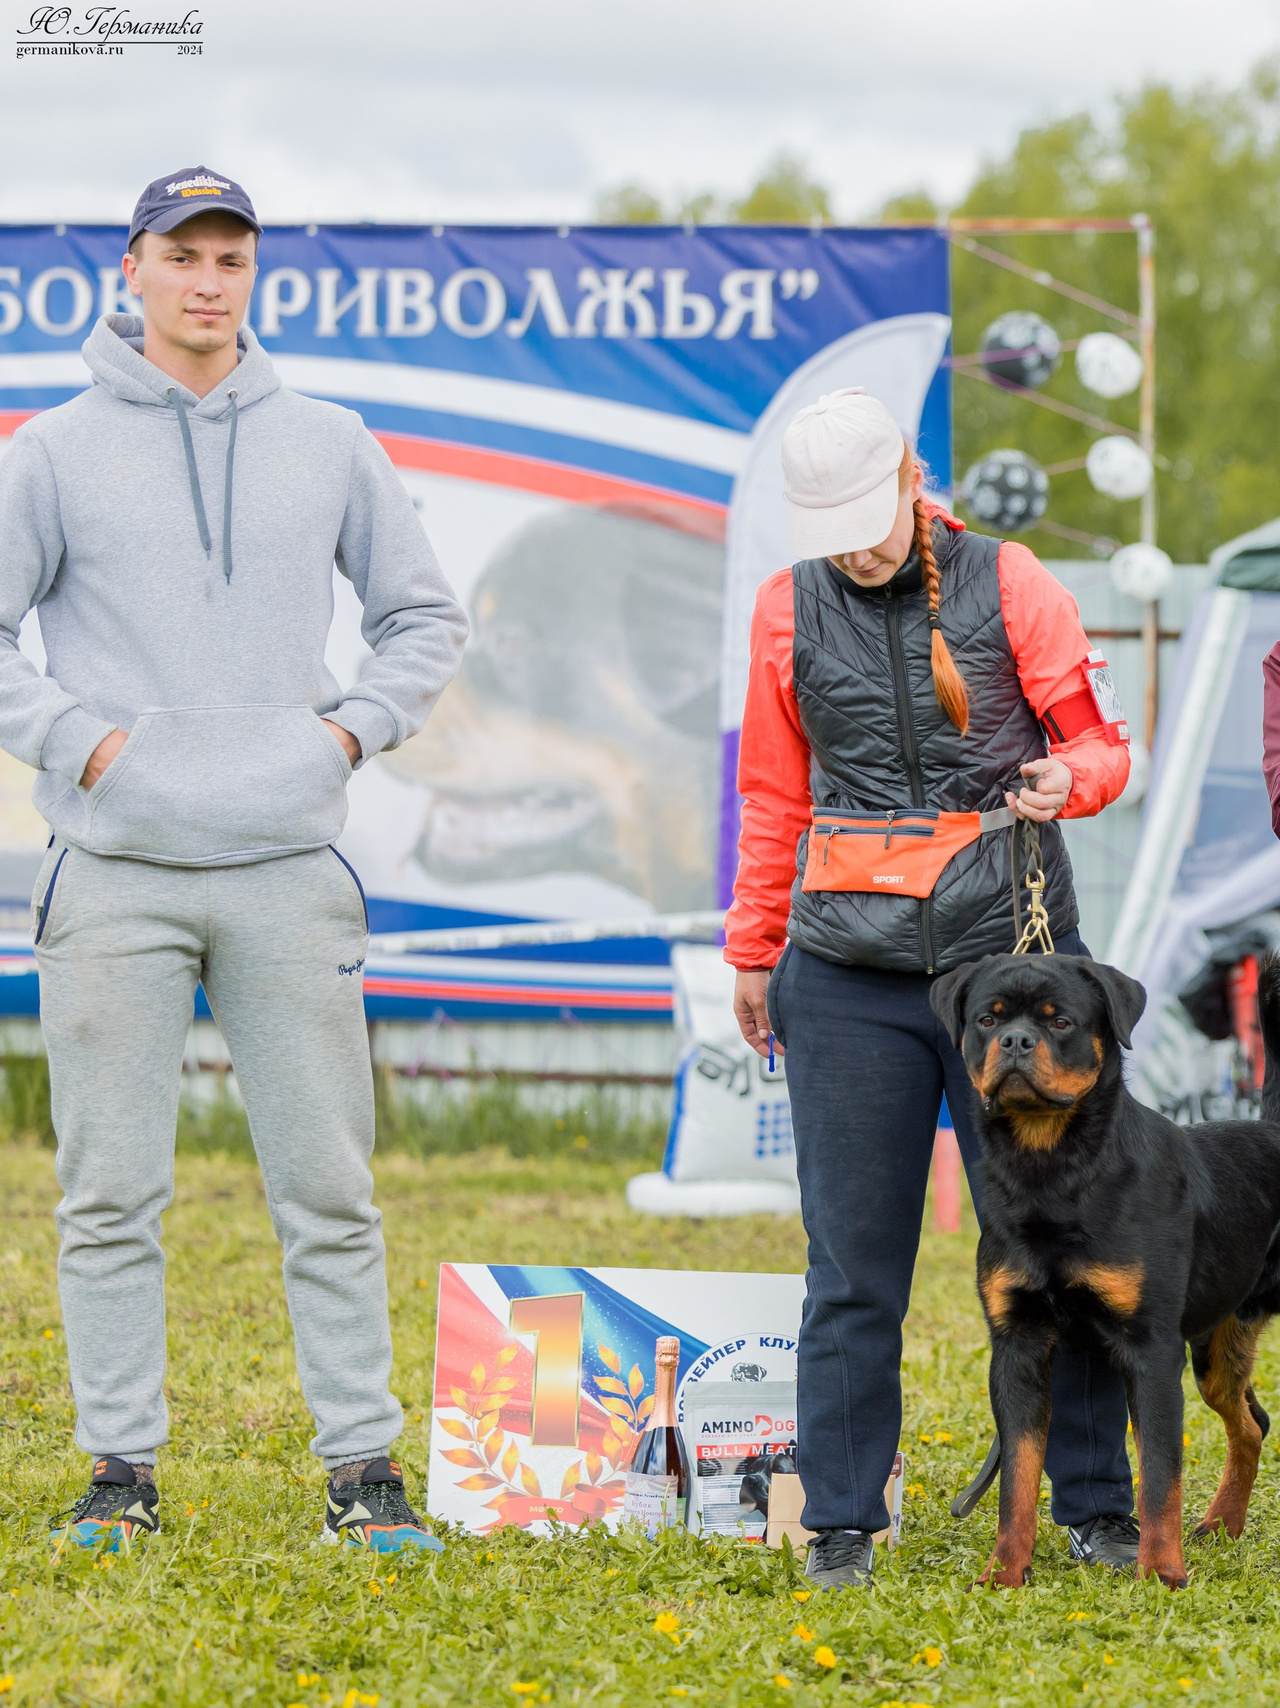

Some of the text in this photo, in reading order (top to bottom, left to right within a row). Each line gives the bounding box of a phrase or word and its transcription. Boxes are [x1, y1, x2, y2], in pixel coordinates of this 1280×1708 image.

[256, 266, 819, 341] РИВОЛЖЬЯ”
[759, 1336, 799, 1354] КЛУ
[510, 1291, 586, 1449] 1
[701, 1445, 797, 1458] BULL MEAT
[529, 1506, 564, 1514] мео
